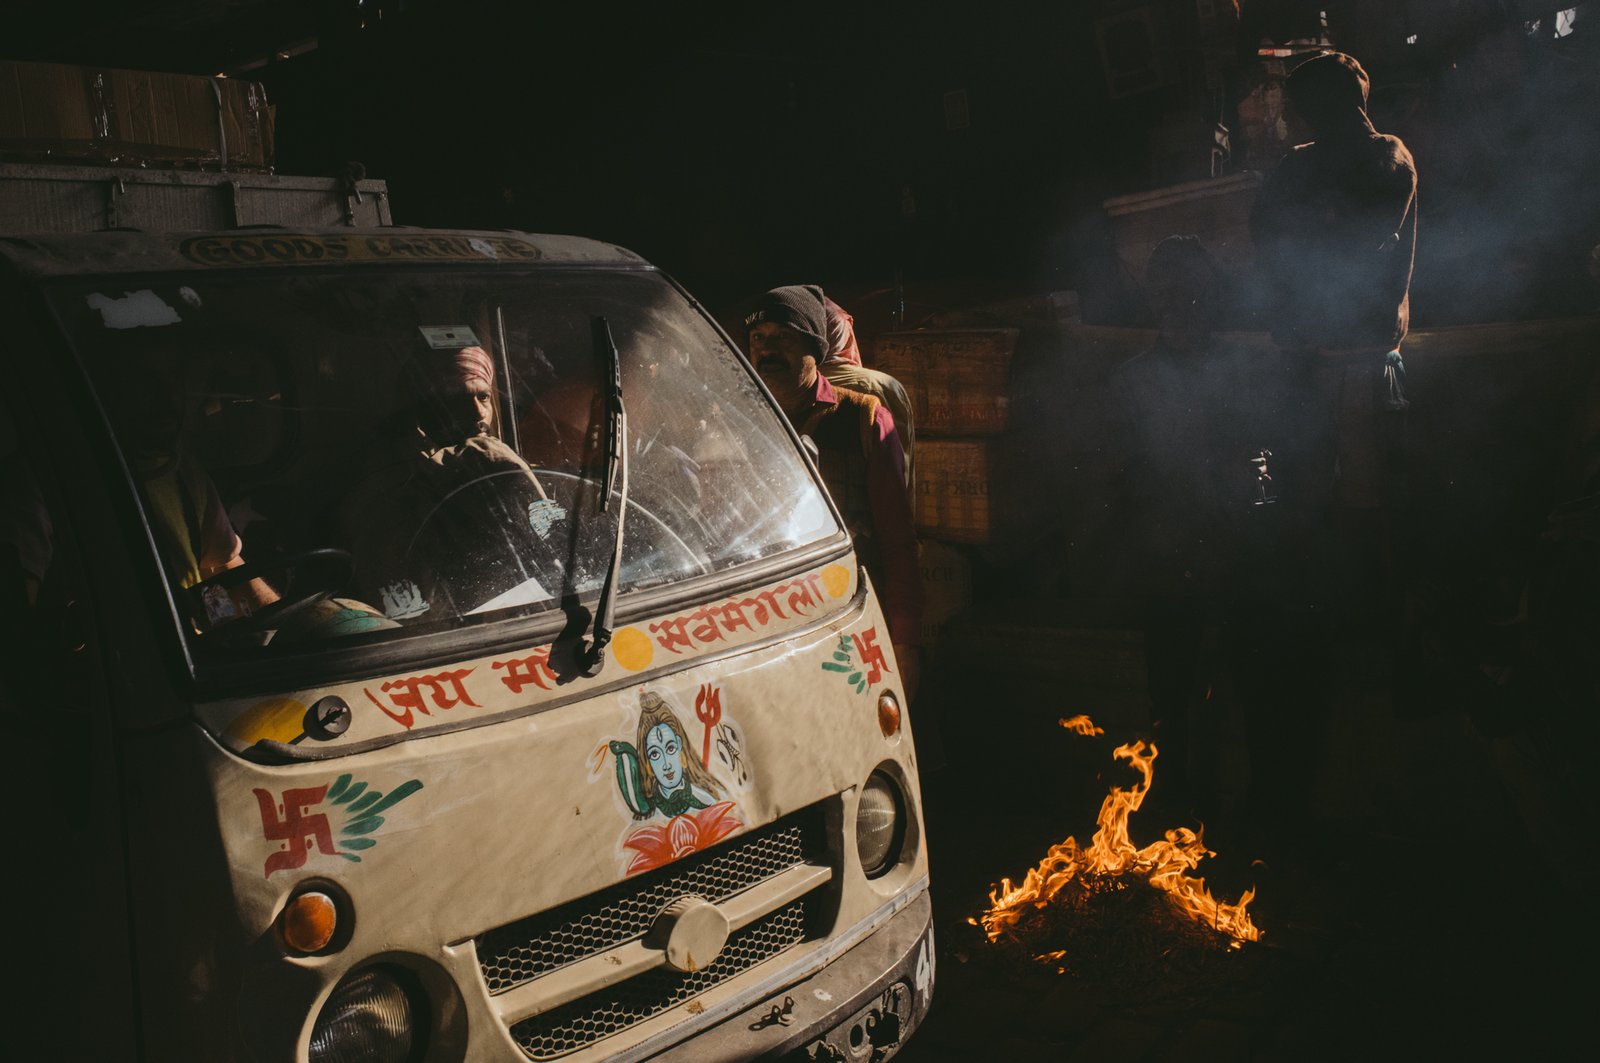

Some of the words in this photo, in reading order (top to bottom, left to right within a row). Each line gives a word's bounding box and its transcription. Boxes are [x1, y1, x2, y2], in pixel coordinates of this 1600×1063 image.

[196, 237, 348, 260] GOODS
[366, 237, 534, 258] CARRIGE
[363, 665, 484, 731] जय
